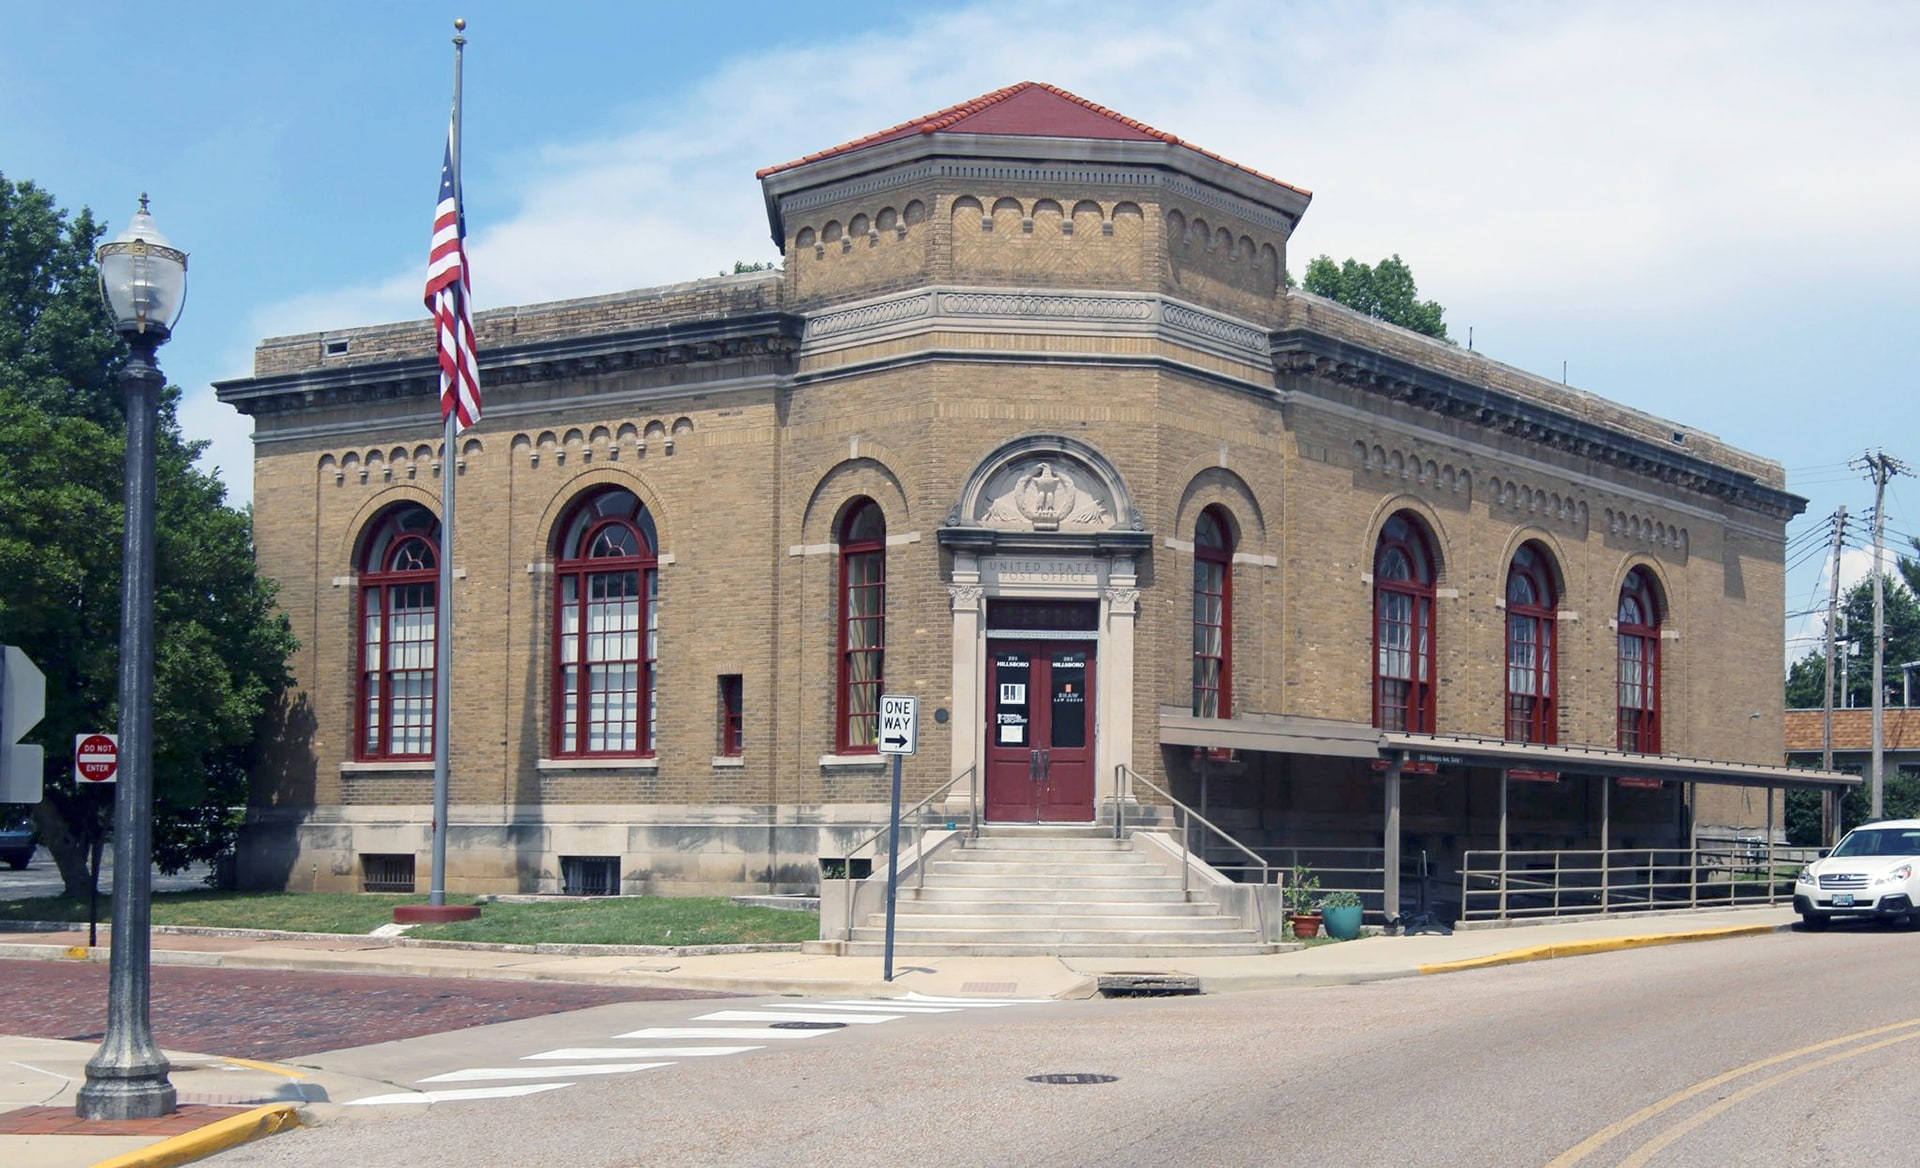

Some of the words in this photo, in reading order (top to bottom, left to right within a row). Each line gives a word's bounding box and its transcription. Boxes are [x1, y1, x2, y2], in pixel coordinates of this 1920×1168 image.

[989, 561, 1040, 572] UNITED
[1049, 562, 1099, 573] STATES
[1001, 572, 1033, 581] POST
[1040, 573, 1088, 582] OFFICE
[885, 701, 911, 714] ONE
[884, 717, 911, 730] WAY
[84, 744, 95, 752] DO
[97, 744, 112, 752] NOT
[86, 764, 110, 772] ENTER
